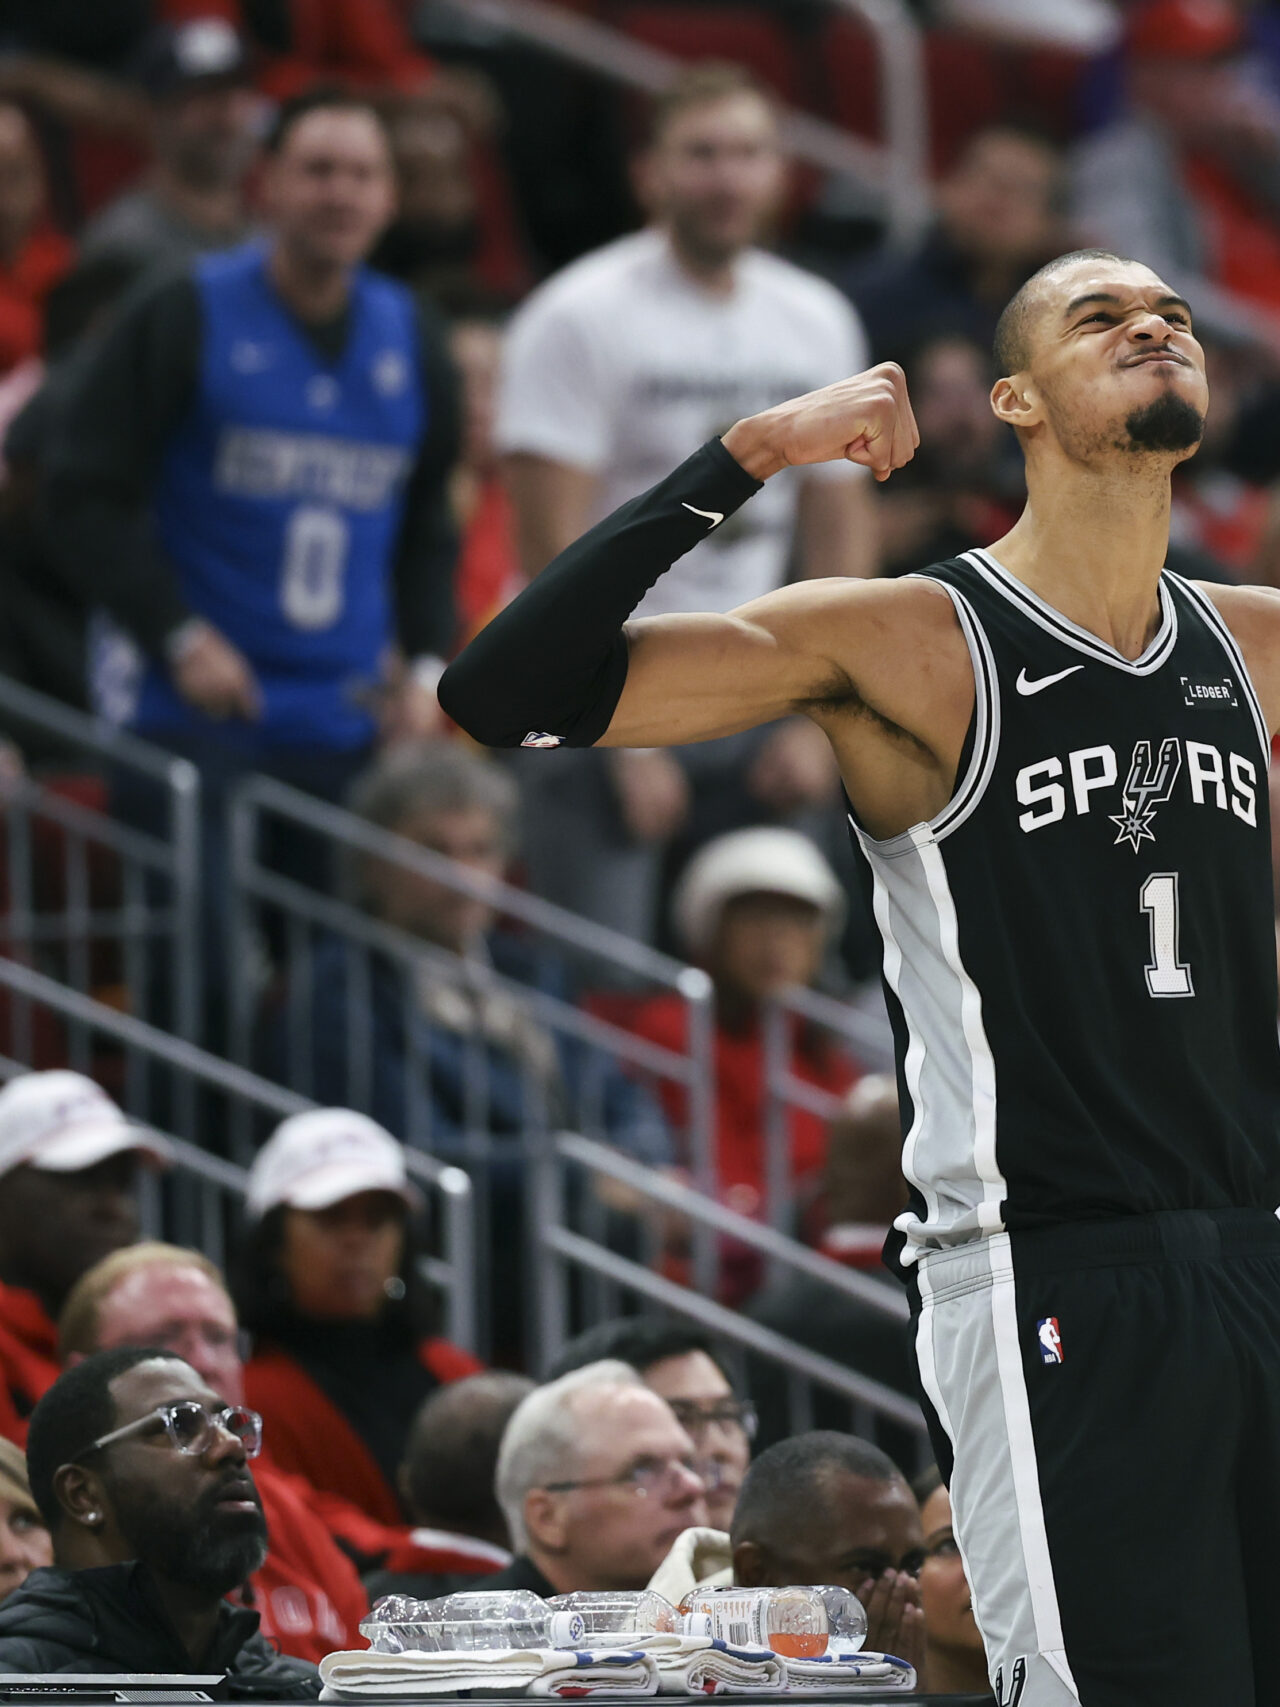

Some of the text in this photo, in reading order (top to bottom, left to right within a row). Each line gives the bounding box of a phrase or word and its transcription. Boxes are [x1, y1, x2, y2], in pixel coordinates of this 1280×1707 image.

[280, 506, 348, 629] 0
[1188, 684, 1231, 699] LEDGER
[1015, 737, 1258, 854] SPURS
[1139, 871, 1196, 998] 1
